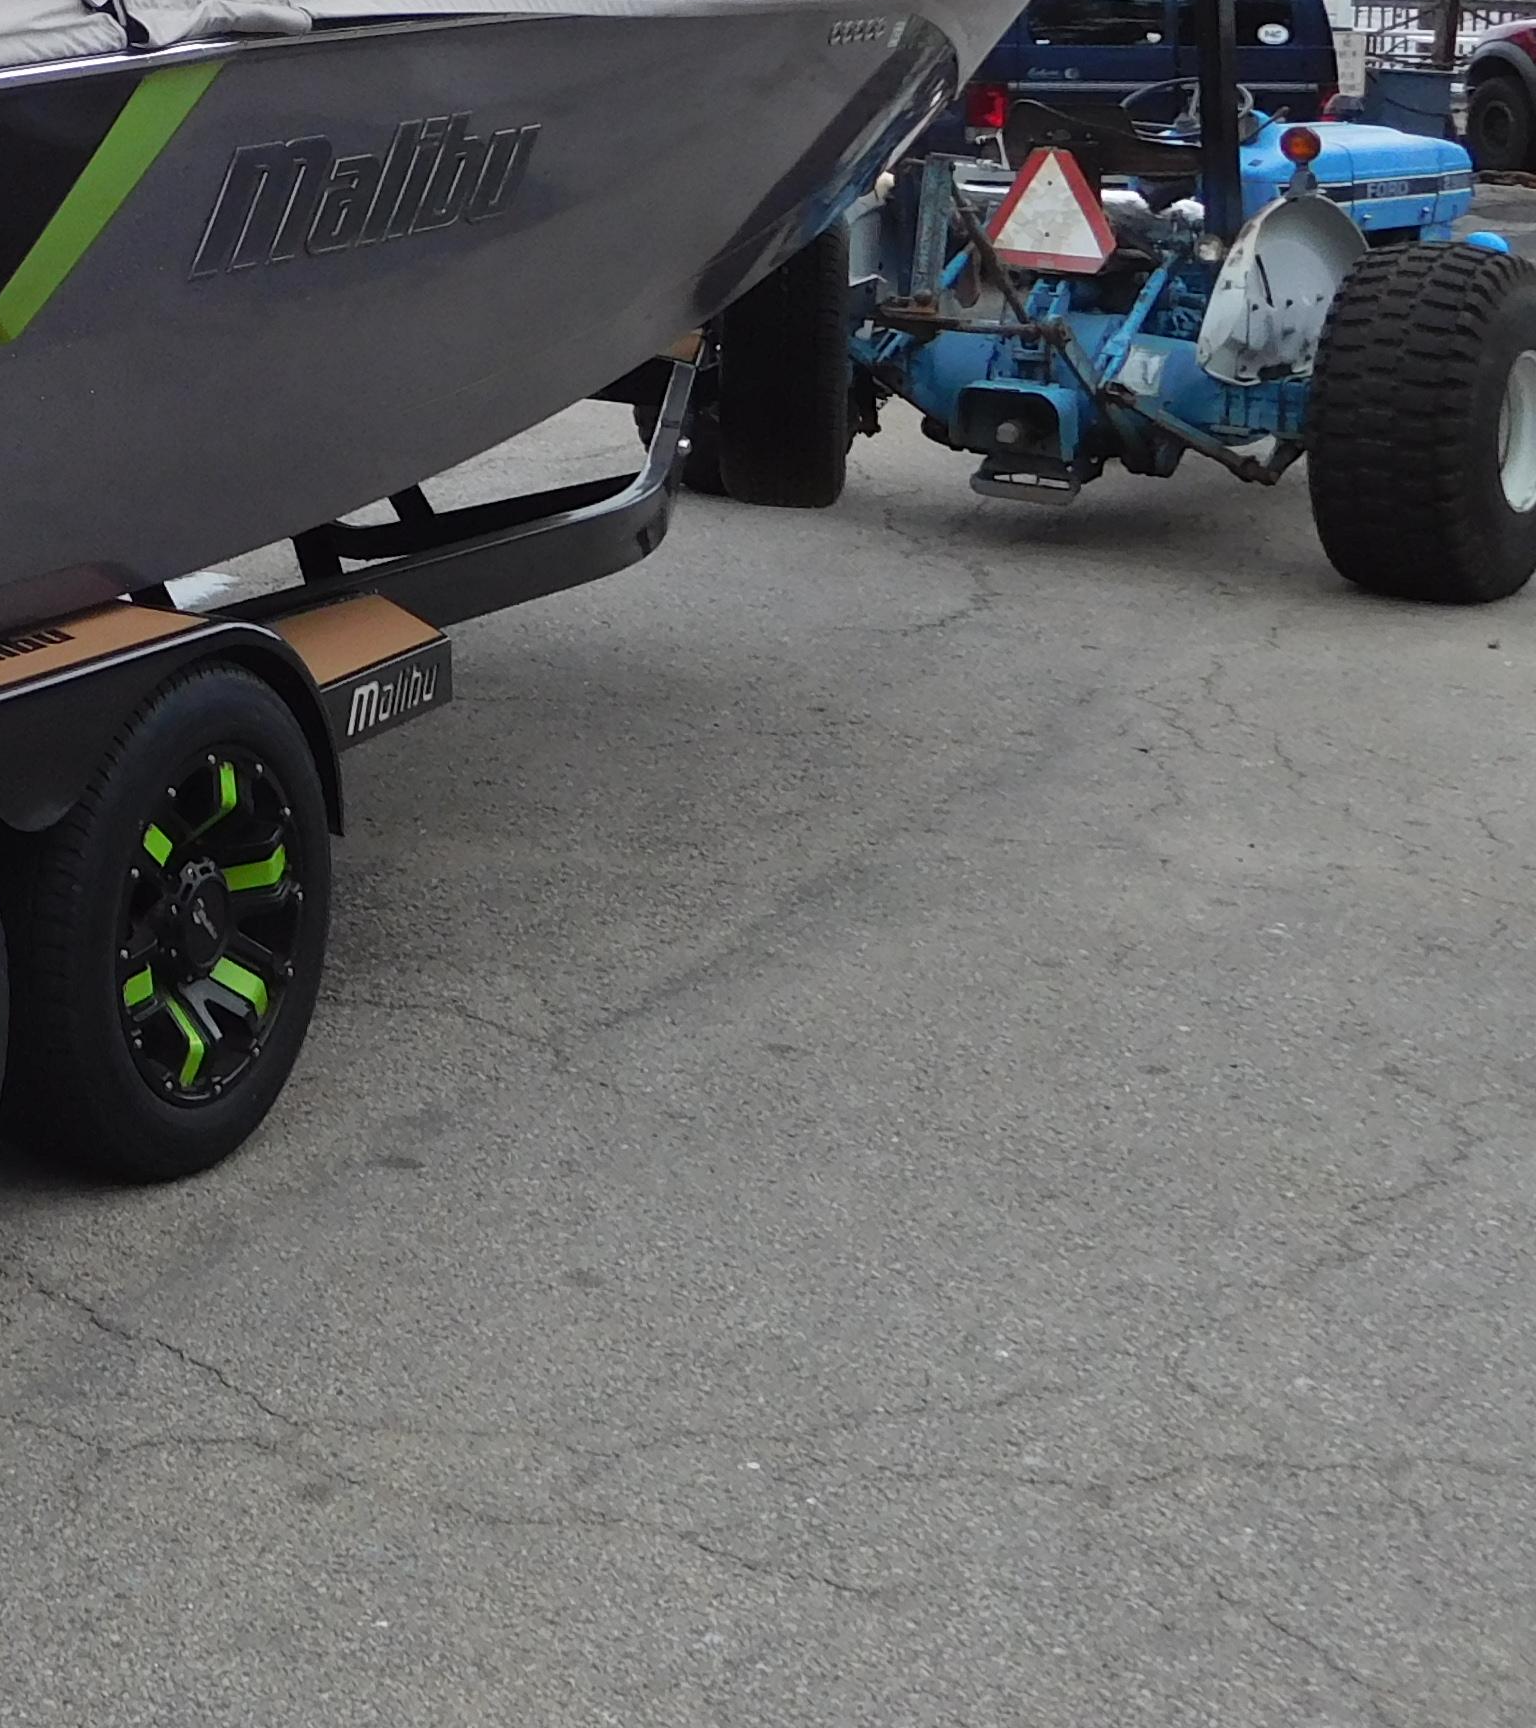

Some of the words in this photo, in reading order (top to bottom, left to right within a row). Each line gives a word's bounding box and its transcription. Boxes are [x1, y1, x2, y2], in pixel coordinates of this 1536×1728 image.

[188, 110, 542, 282] Malibu
[1366, 181, 1408, 199] FORD
[346, 663, 439, 737] Malibu
